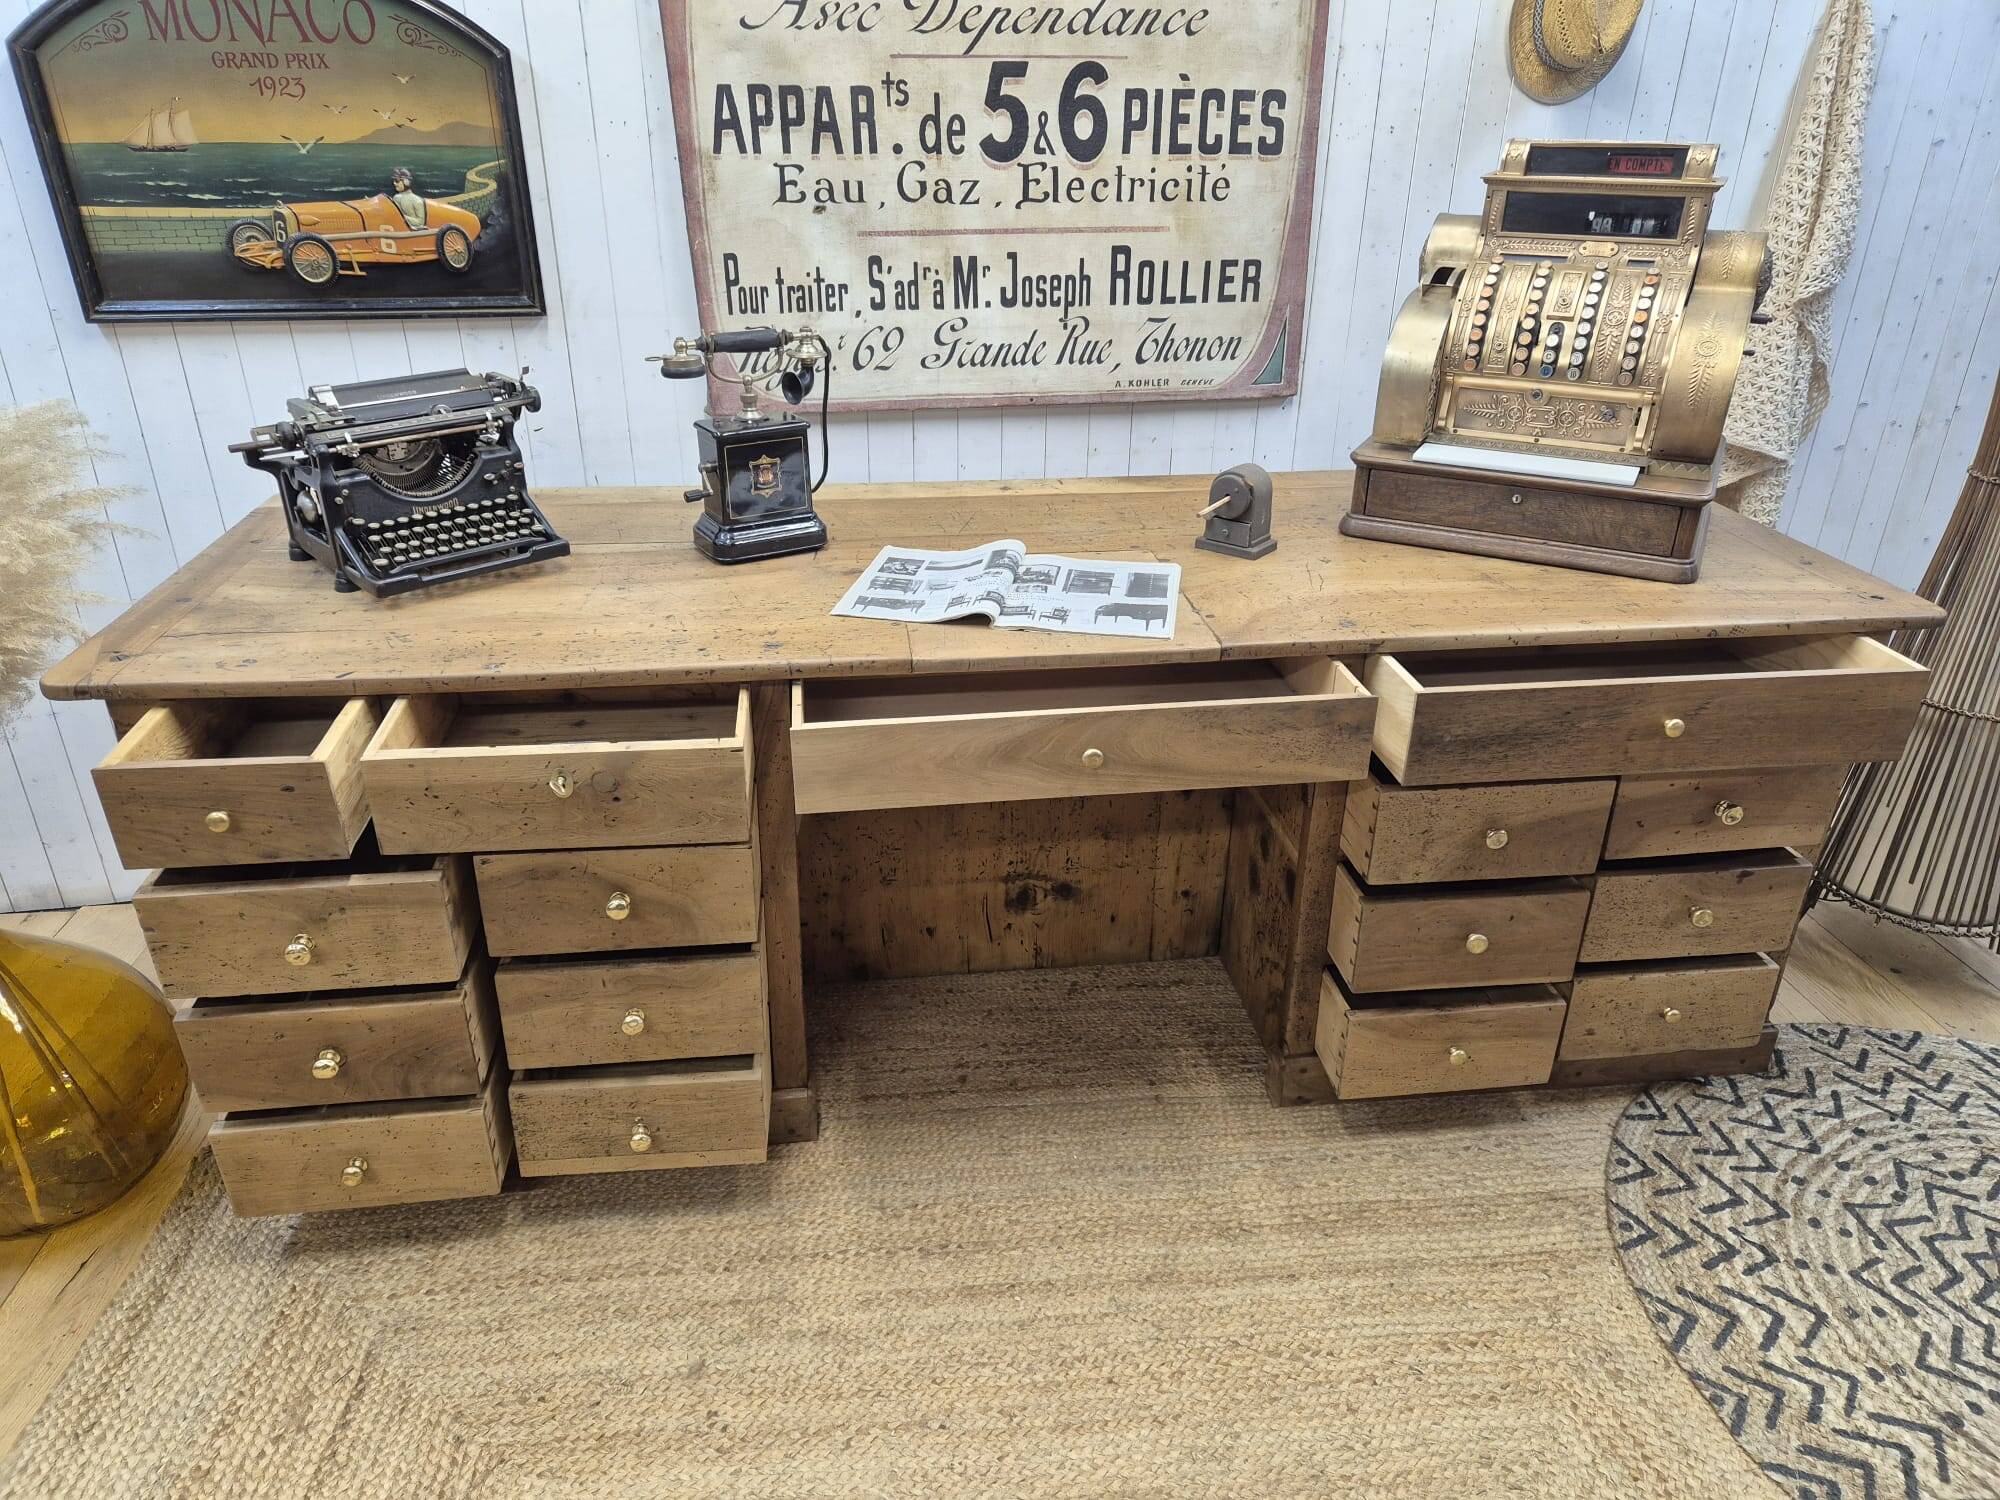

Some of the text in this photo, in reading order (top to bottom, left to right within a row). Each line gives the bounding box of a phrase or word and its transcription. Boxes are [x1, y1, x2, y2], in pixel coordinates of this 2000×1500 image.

[138, 0, 376, 47] MONACO
[211, 51, 330, 70] GRAND PRIX
[249, 75, 306, 103] 1923
[919, 92, 966, 155] de
[1121, 73, 1287, 155] PIÈCES
[1015, 161, 1231, 209] Electricité
[1626, 158, 1665, 172] COMPTE
[276, 221, 286, 242] 6
[723, 252, 769, 315] Pour
[1000, 251, 1092, 319] Joseph
[1109, 245, 1262, 305] ROLLIER
[852, 325, 905, 371] 62
[1135, 314, 1243, 365] Thonon
